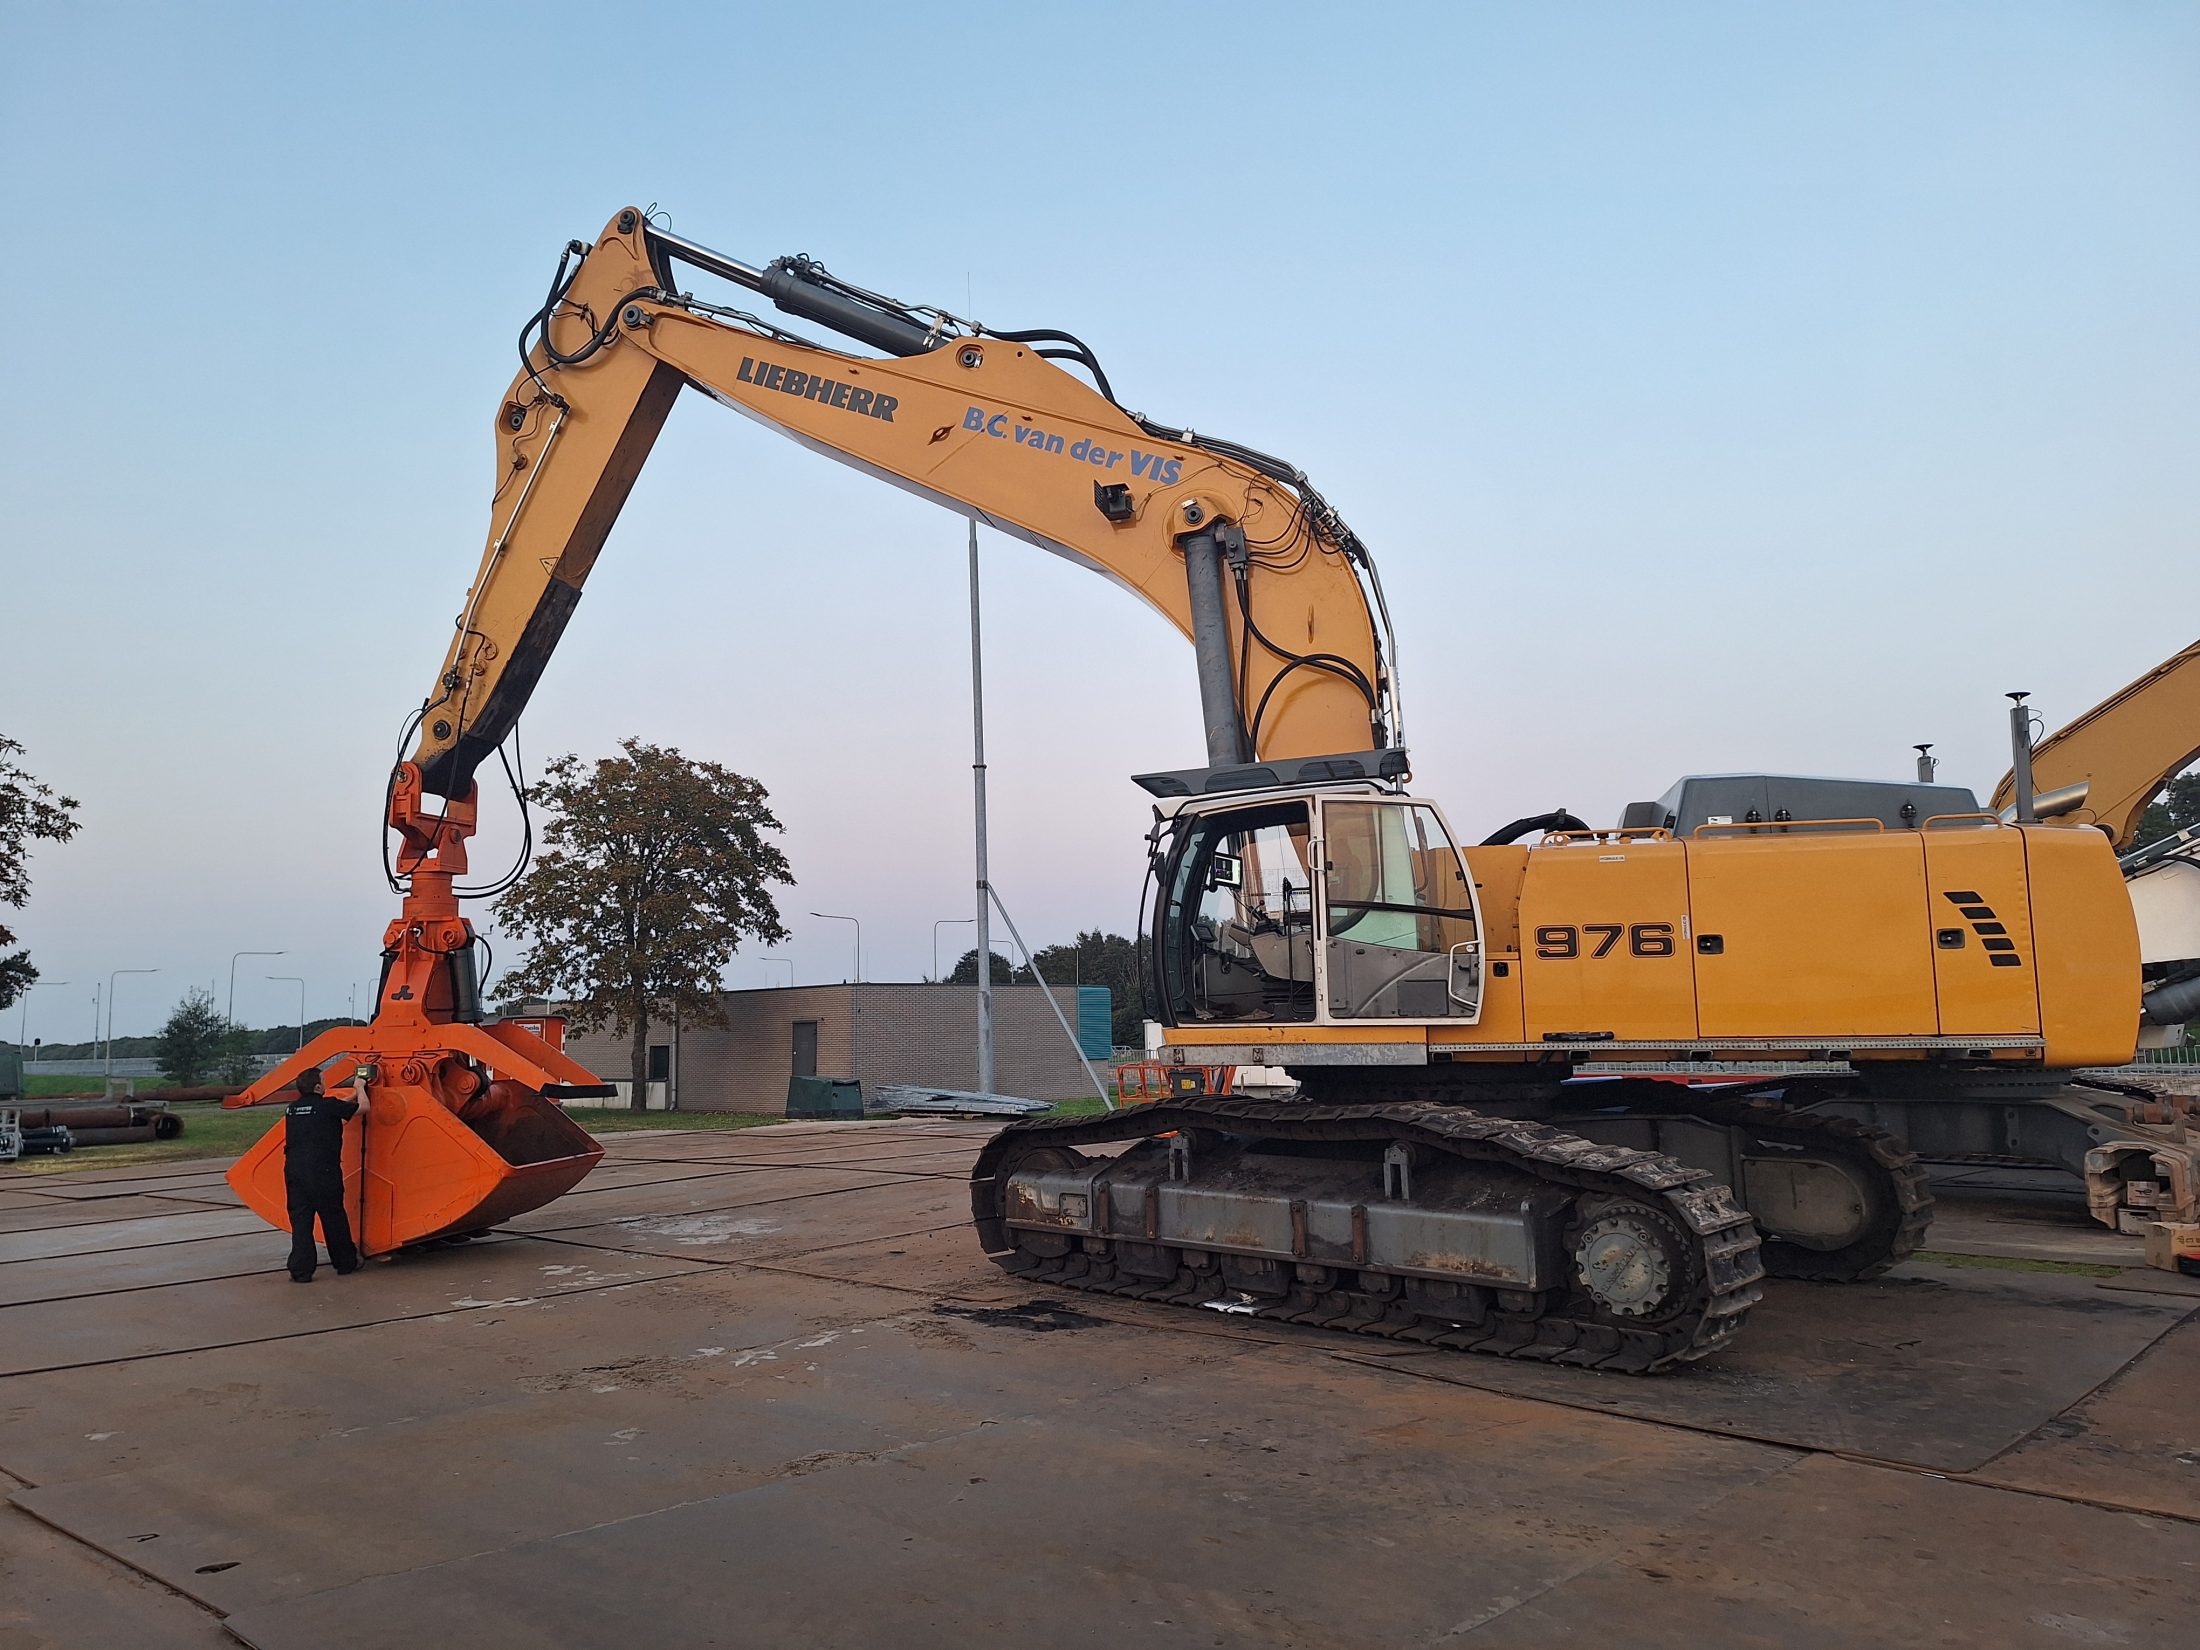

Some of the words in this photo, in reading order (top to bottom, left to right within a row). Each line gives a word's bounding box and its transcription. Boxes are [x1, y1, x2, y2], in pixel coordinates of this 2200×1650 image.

[736, 356, 898, 422] LIEBHERR
[962, 406, 1008, 439] B.C.
[1014, 424, 1065, 454] van
[1070, 438, 1123, 469] der
[1130, 449, 1183, 485] VIS
[1535, 922, 1675, 960] 976
